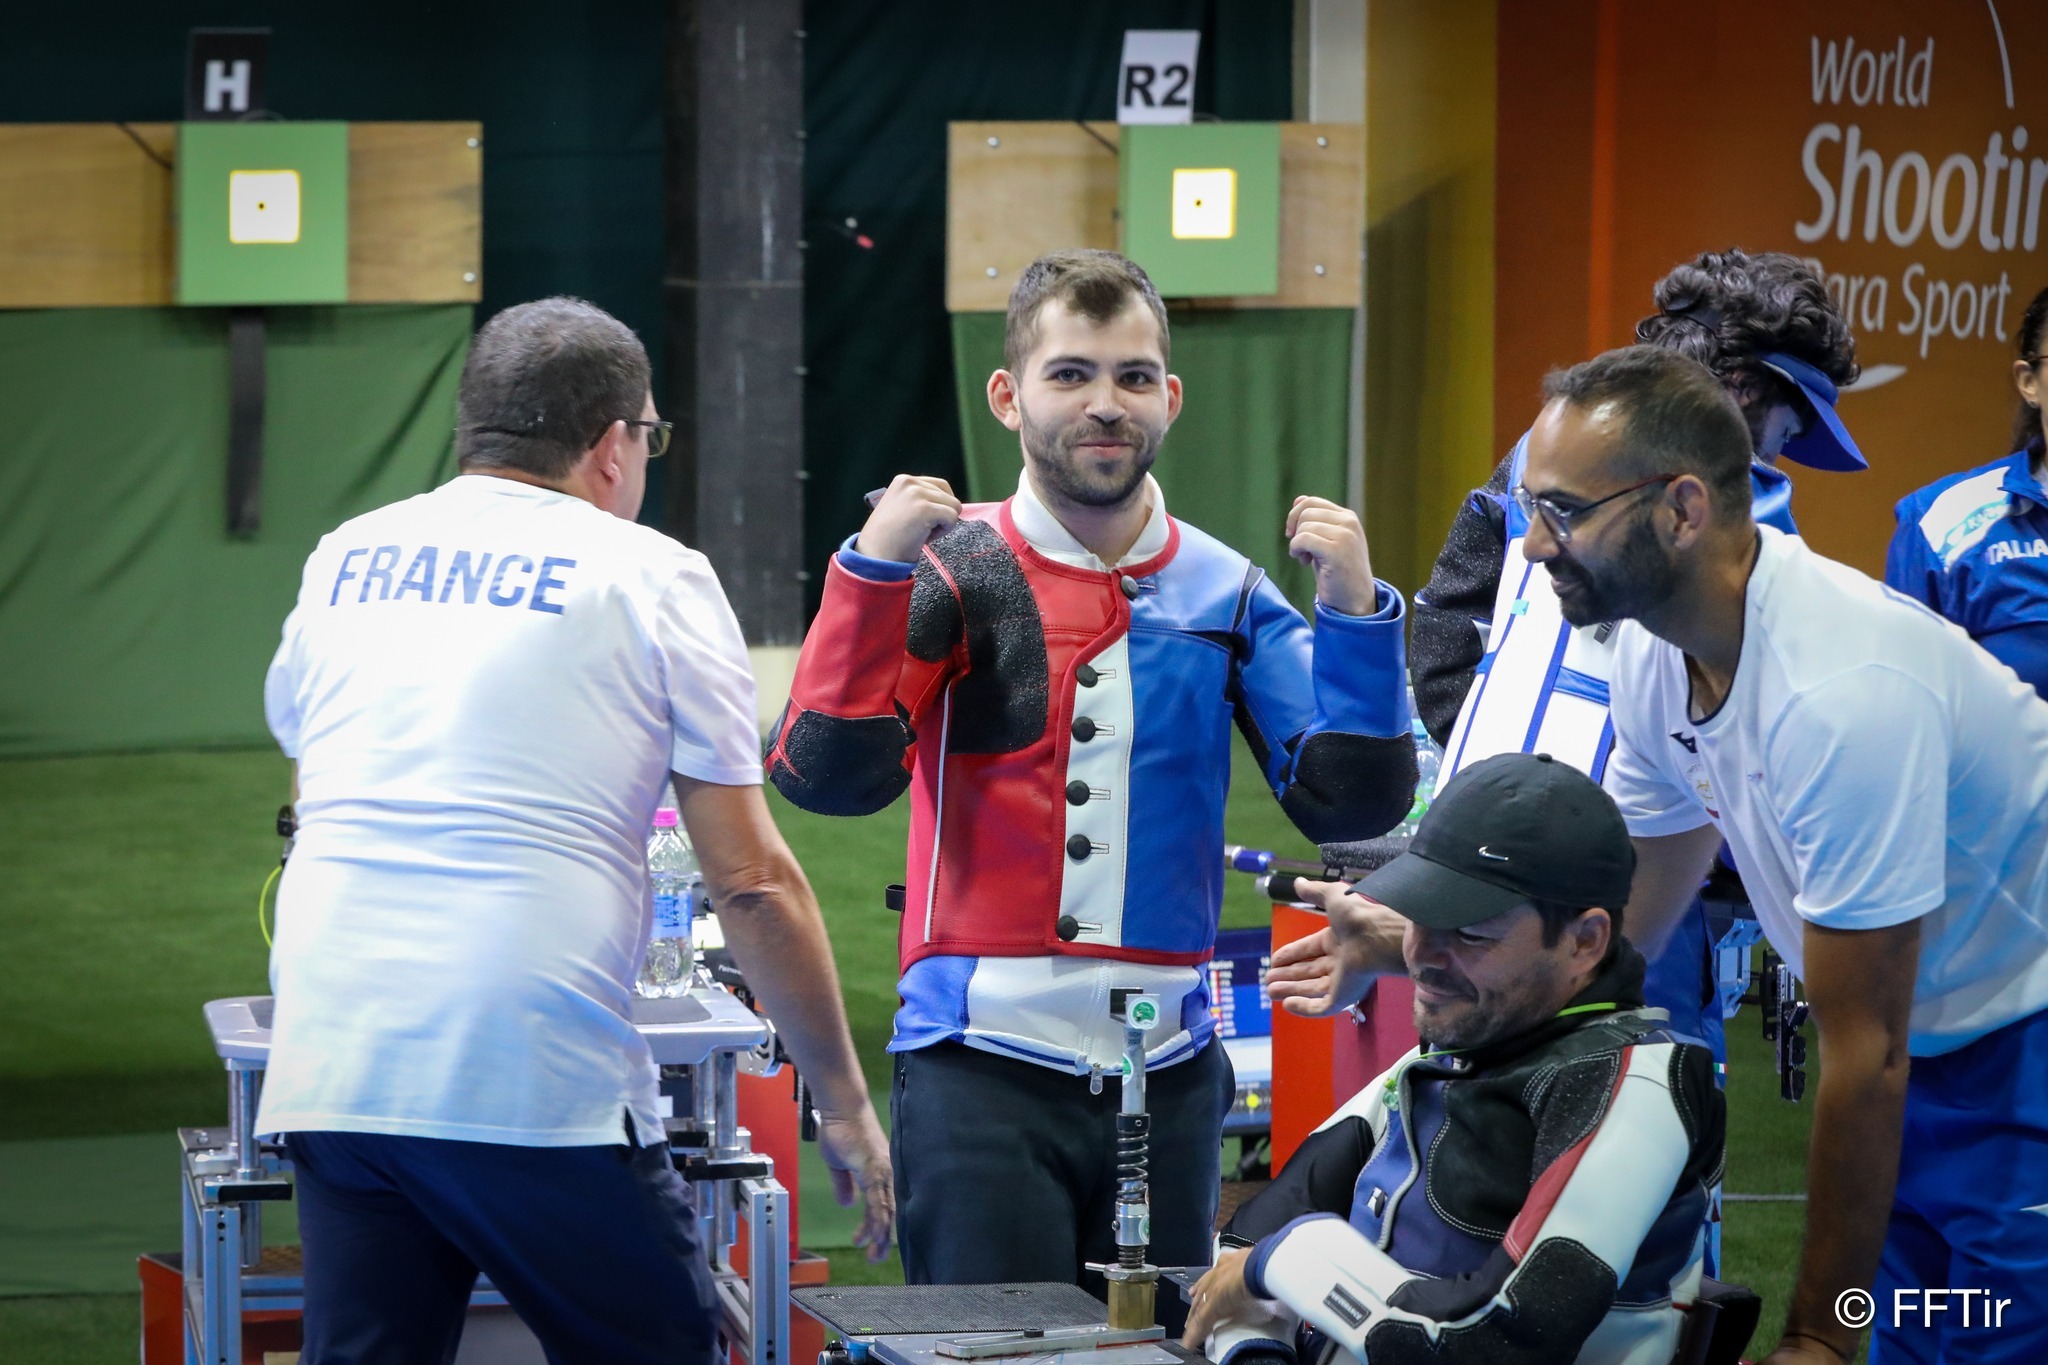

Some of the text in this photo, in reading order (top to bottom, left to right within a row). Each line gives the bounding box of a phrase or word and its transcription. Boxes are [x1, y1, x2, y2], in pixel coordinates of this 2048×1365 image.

[204, 60, 251, 112] H
[1123, 63, 1190, 107] R2
[1811, 35, 1935, 107] World
[1897, 263, 2012, 359] Sport
[329, 545, 578, 616] FRANCE
[1986, 538, 2048, 566] TALIA
